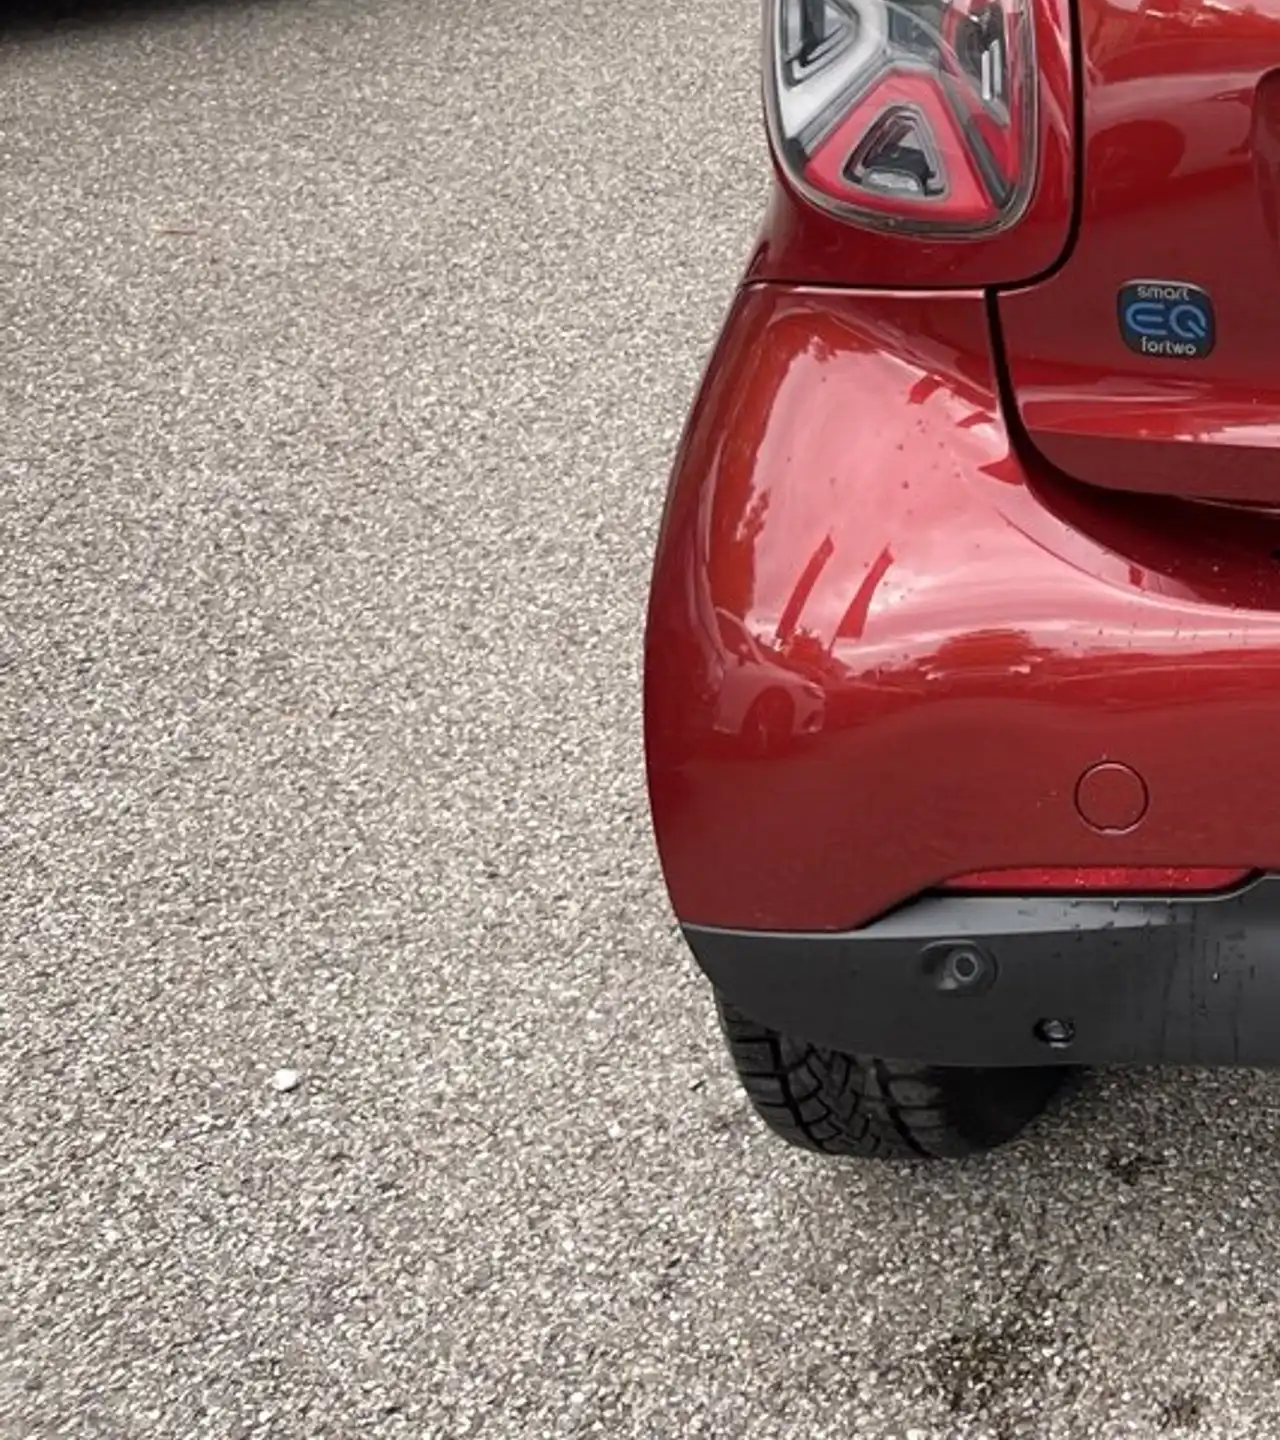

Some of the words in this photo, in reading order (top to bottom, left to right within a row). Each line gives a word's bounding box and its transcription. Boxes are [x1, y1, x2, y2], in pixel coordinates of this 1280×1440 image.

[1137, 286, 1190, 300] smart
[1126, 302, 1207, 339] EQ
[1141, 337, 1196, 355] fortwo
